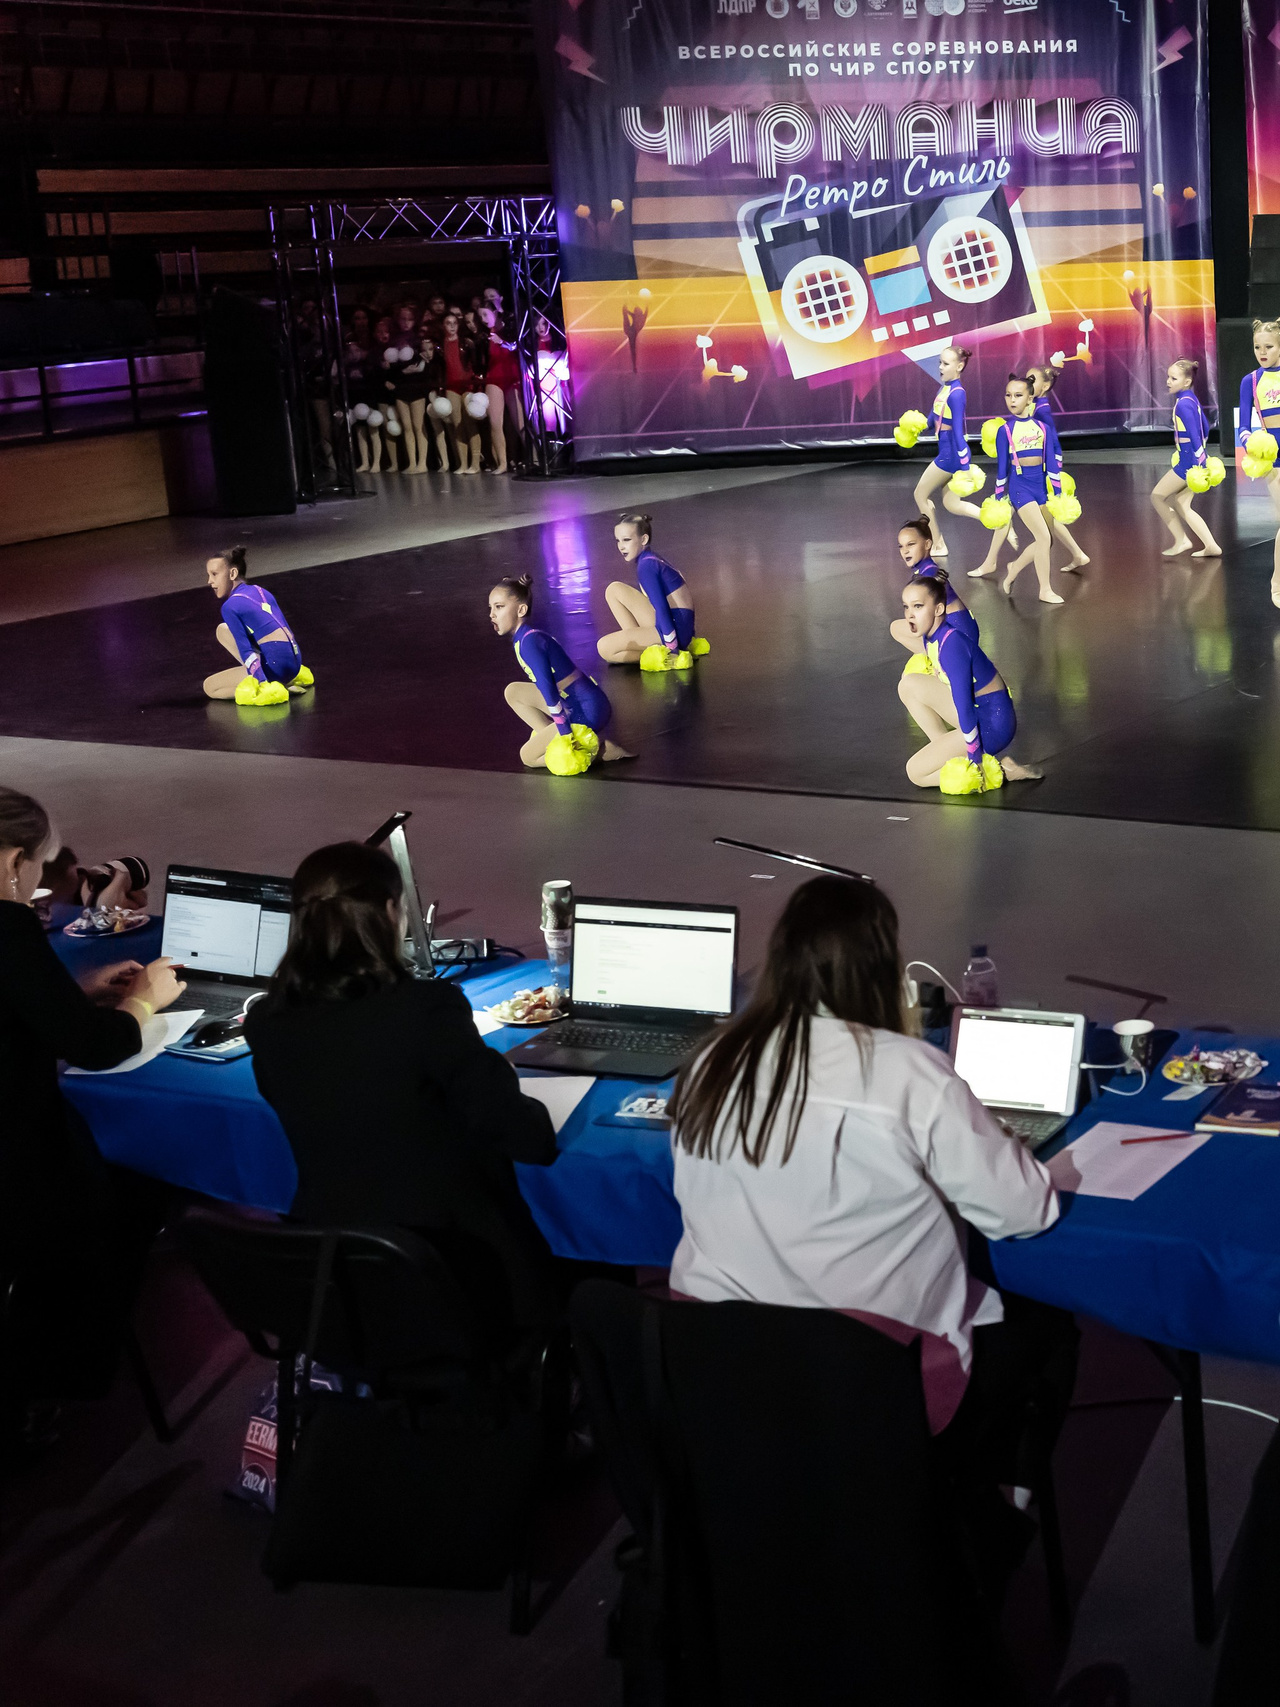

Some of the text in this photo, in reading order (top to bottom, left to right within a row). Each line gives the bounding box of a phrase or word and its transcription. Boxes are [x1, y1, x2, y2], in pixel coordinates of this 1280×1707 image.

[716, 0, 757, 16] ЛДПР
[677, 38, 1079, 60] ВСЕРОССИЙСКИЕ СОРЕВНОВАНИЯ
[788, 59, 976, 77] ПО ЧИР СПОРТУ
[780, 154, 1011, 217] Ретро Стиль
[241, 1470, 267, 1494] 2024
